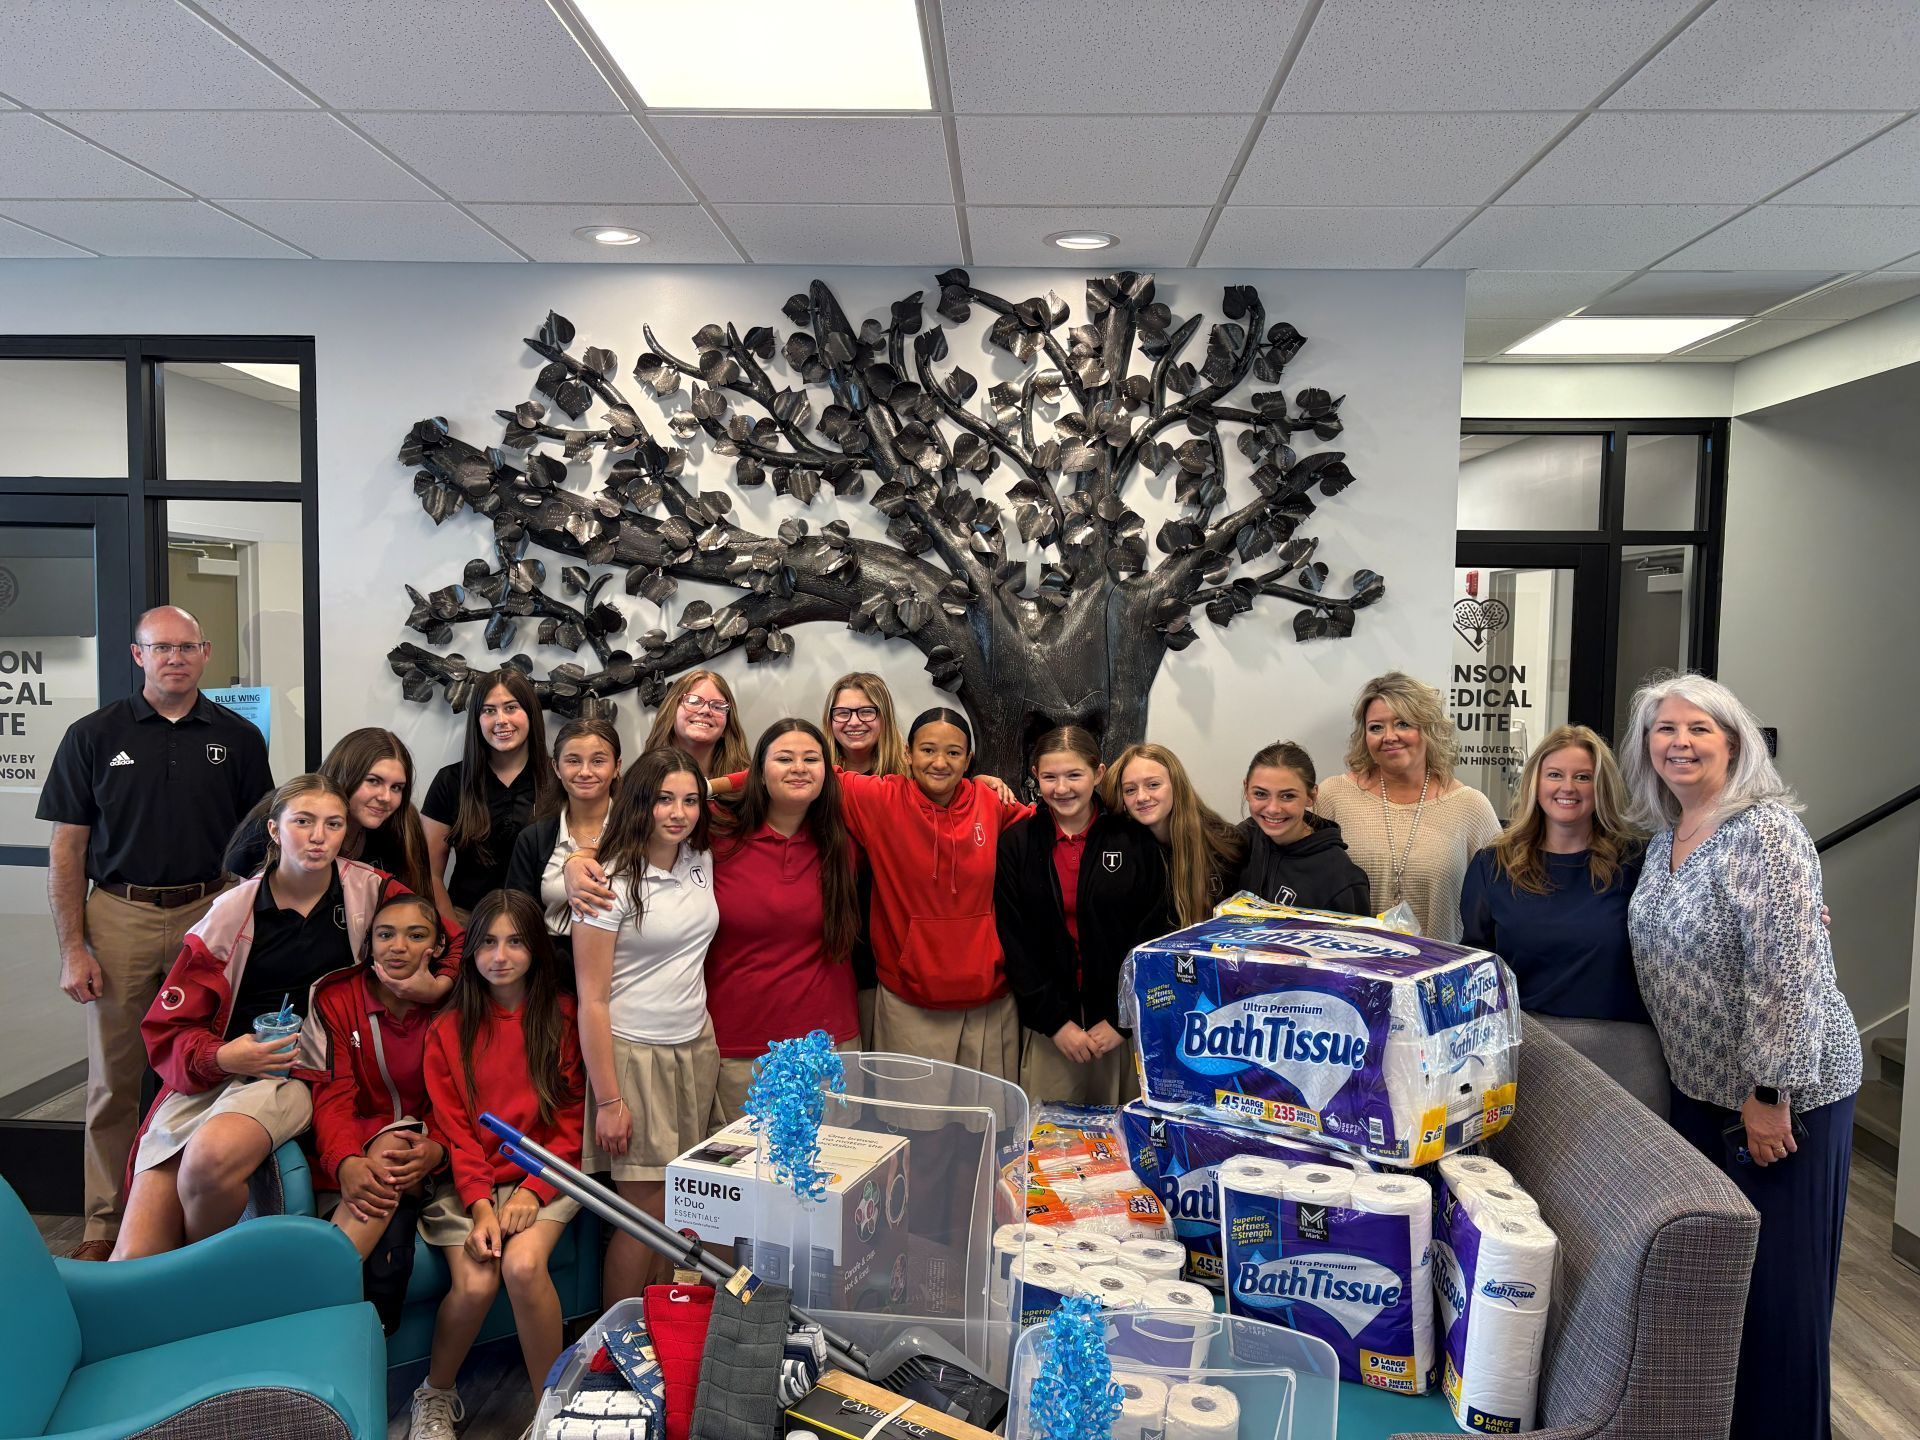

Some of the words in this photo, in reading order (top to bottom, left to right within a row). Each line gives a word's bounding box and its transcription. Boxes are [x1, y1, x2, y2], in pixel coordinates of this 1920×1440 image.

[215, 694, 237, 703] BLUE
[238, 694, 260, 702] WING
[1450, 712, 1510, 732] UITE
[1476, 745, 1500, 753] LOVE
[1502, 746, 1515, 754] BY
[20, 754, 35, 764] BY
[110, 759, 135, 767] adidas
[1471, 757, 1515, 766] HINSON
[1106, 853, 1119, 867] T
[1242, 1002, 1268, 1013] Ultra
[1270, 1004, 1323, 1015] Premium
[1184, 1012, 1367, 1069] BathTissue
[1221, 1095, 1239, 1110] 45
[1241, 1097, 1264, 1109] LARGE
[1273, 1104, 1295, 1122] 235
[1486, 1108, 1498, 1124] 235
[674, 1176, 742, 1201] KEURIG
[674, 1209, 719, 1223] ESSENTIALS
[1232, 1214, 1266, 1225] Superior
[1232, 1222, 1270, 1233] Softness
[1299, 1226, 1328, 1235] Member's
[1237, 1229, 1272, 1240] Strength
[1196, 1256, 1214, 1272] 45
[1289, 1258, 1312, 1267] Ultra
[1313, 1261, 1357, 1271] Premium
[1238, 1263, 1400, 1307] BathTissue
[1483, 1281, 1536, 1299] BathTissue
[1369, 1356, 1380, 1367] 9
[1380, 1357, 1406, 1367] LARGE
[1365, 1373, 1387, 1387] 235
[1388, 1378, 1413, 1386] SHEETS
[841, 1399, 932, 1437] CAMBIDGE
[1473, 1413, 1485, 1426] 9
[1486, 1417, 1515, 1428] LARGE
